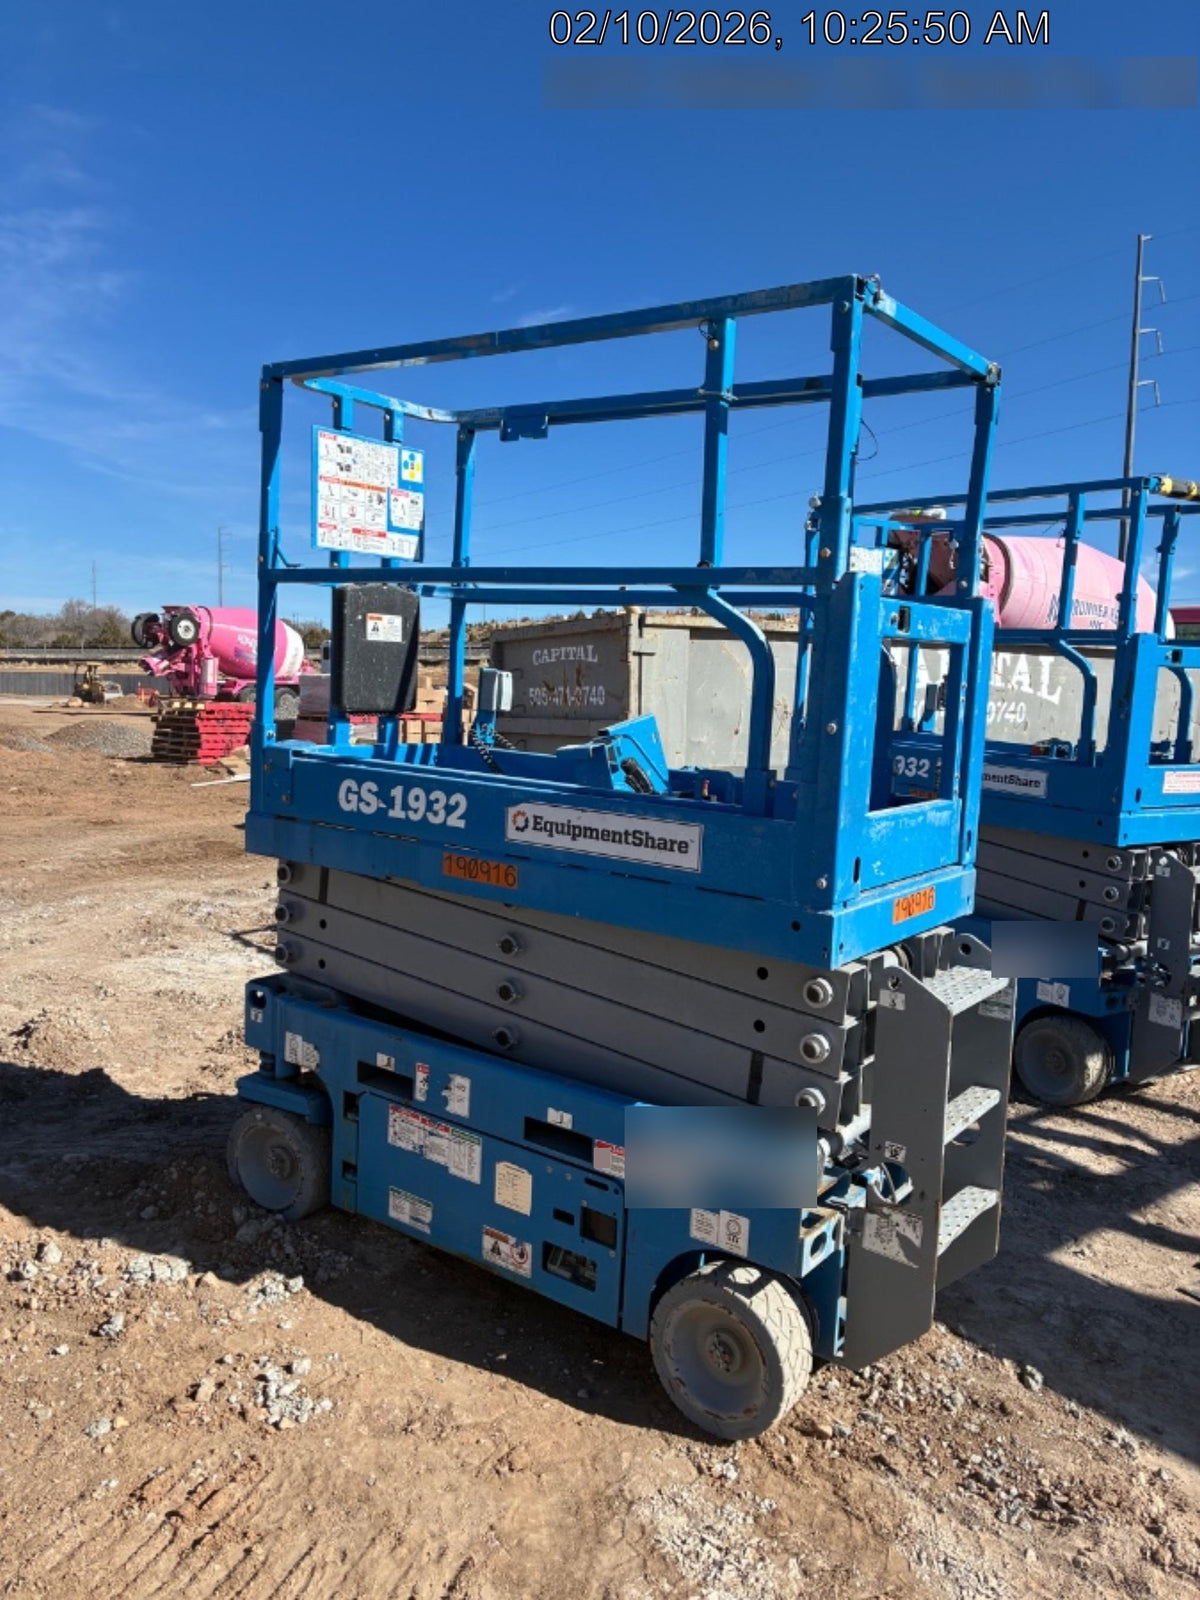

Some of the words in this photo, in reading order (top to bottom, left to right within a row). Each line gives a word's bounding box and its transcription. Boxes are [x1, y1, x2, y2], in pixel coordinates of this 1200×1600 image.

[532, 644, 598, 665] CAPITAL
[338, 779, 467, 828] GS-1932
[532, 815, 690, 854] EquipmentShare
[444, 854, 517, 888] 190916
